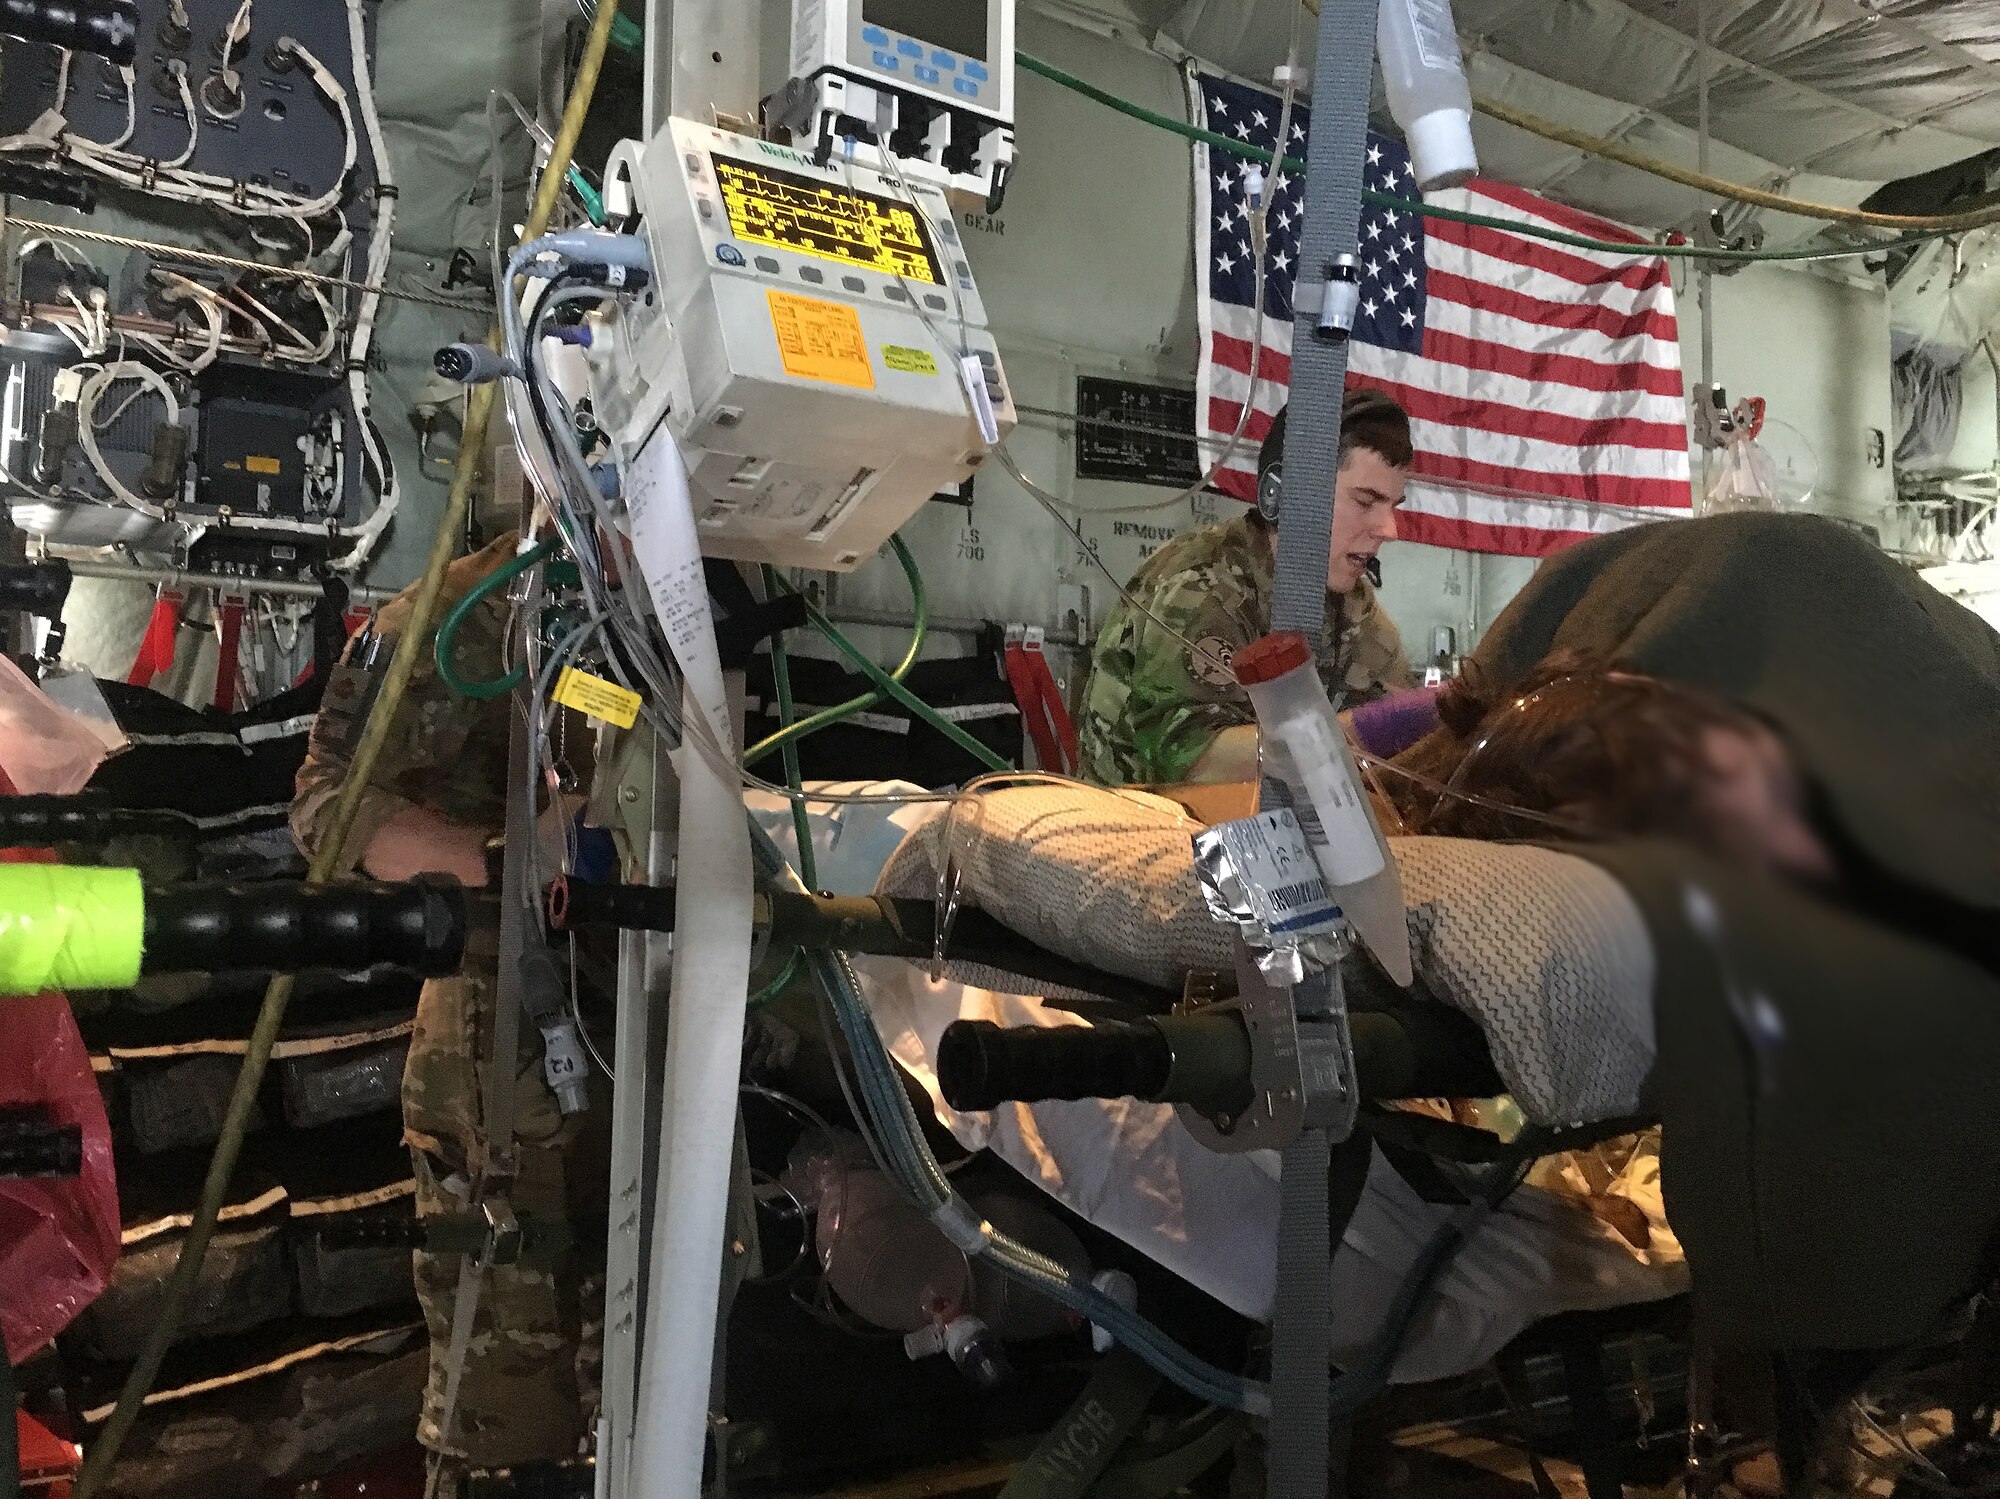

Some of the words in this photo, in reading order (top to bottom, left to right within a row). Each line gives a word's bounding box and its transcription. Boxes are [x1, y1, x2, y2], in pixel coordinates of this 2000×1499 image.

[964, 213, 1006, 235] GEAR
[908, 264, 935, 282] 100
[1113, 521, 1176, 540] REMOVE
[957, 544, 985, 561] 700
